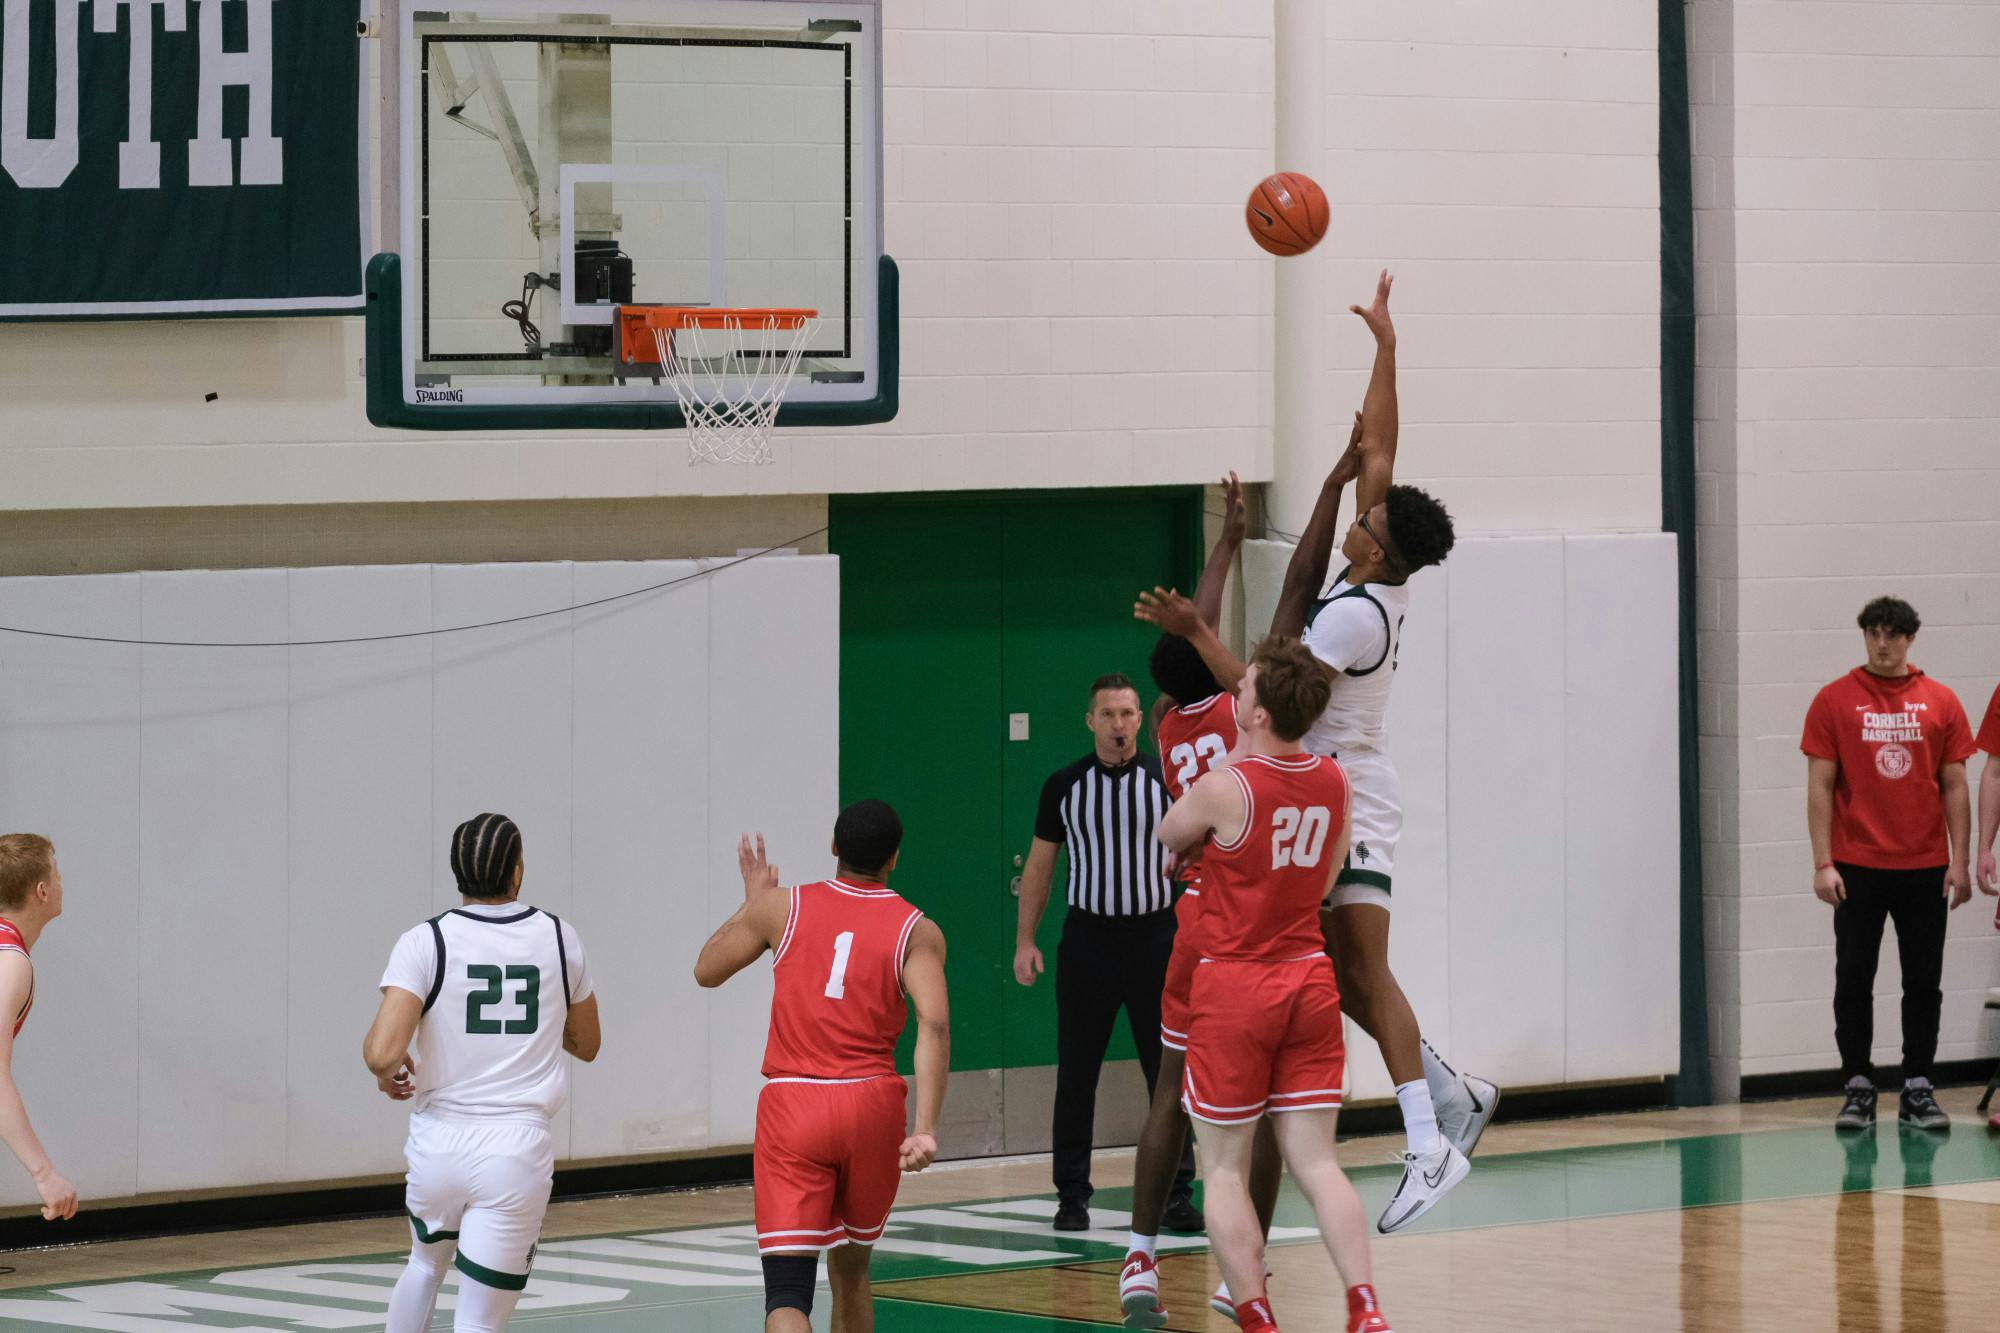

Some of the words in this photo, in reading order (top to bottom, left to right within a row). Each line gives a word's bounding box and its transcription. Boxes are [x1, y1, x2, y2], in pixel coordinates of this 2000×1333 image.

[0, 0, 283, 188] UTH
[416, 389, 463, 403] SPALDING
[1862, 728, 1924, 742] BASKETBALL
[1863, 712, 1920, 728] CORNELL
[1271, 806, 1331, 870] 20
[824, 931, 854, 999] 1
[466, 964, 540, 1034] 23
